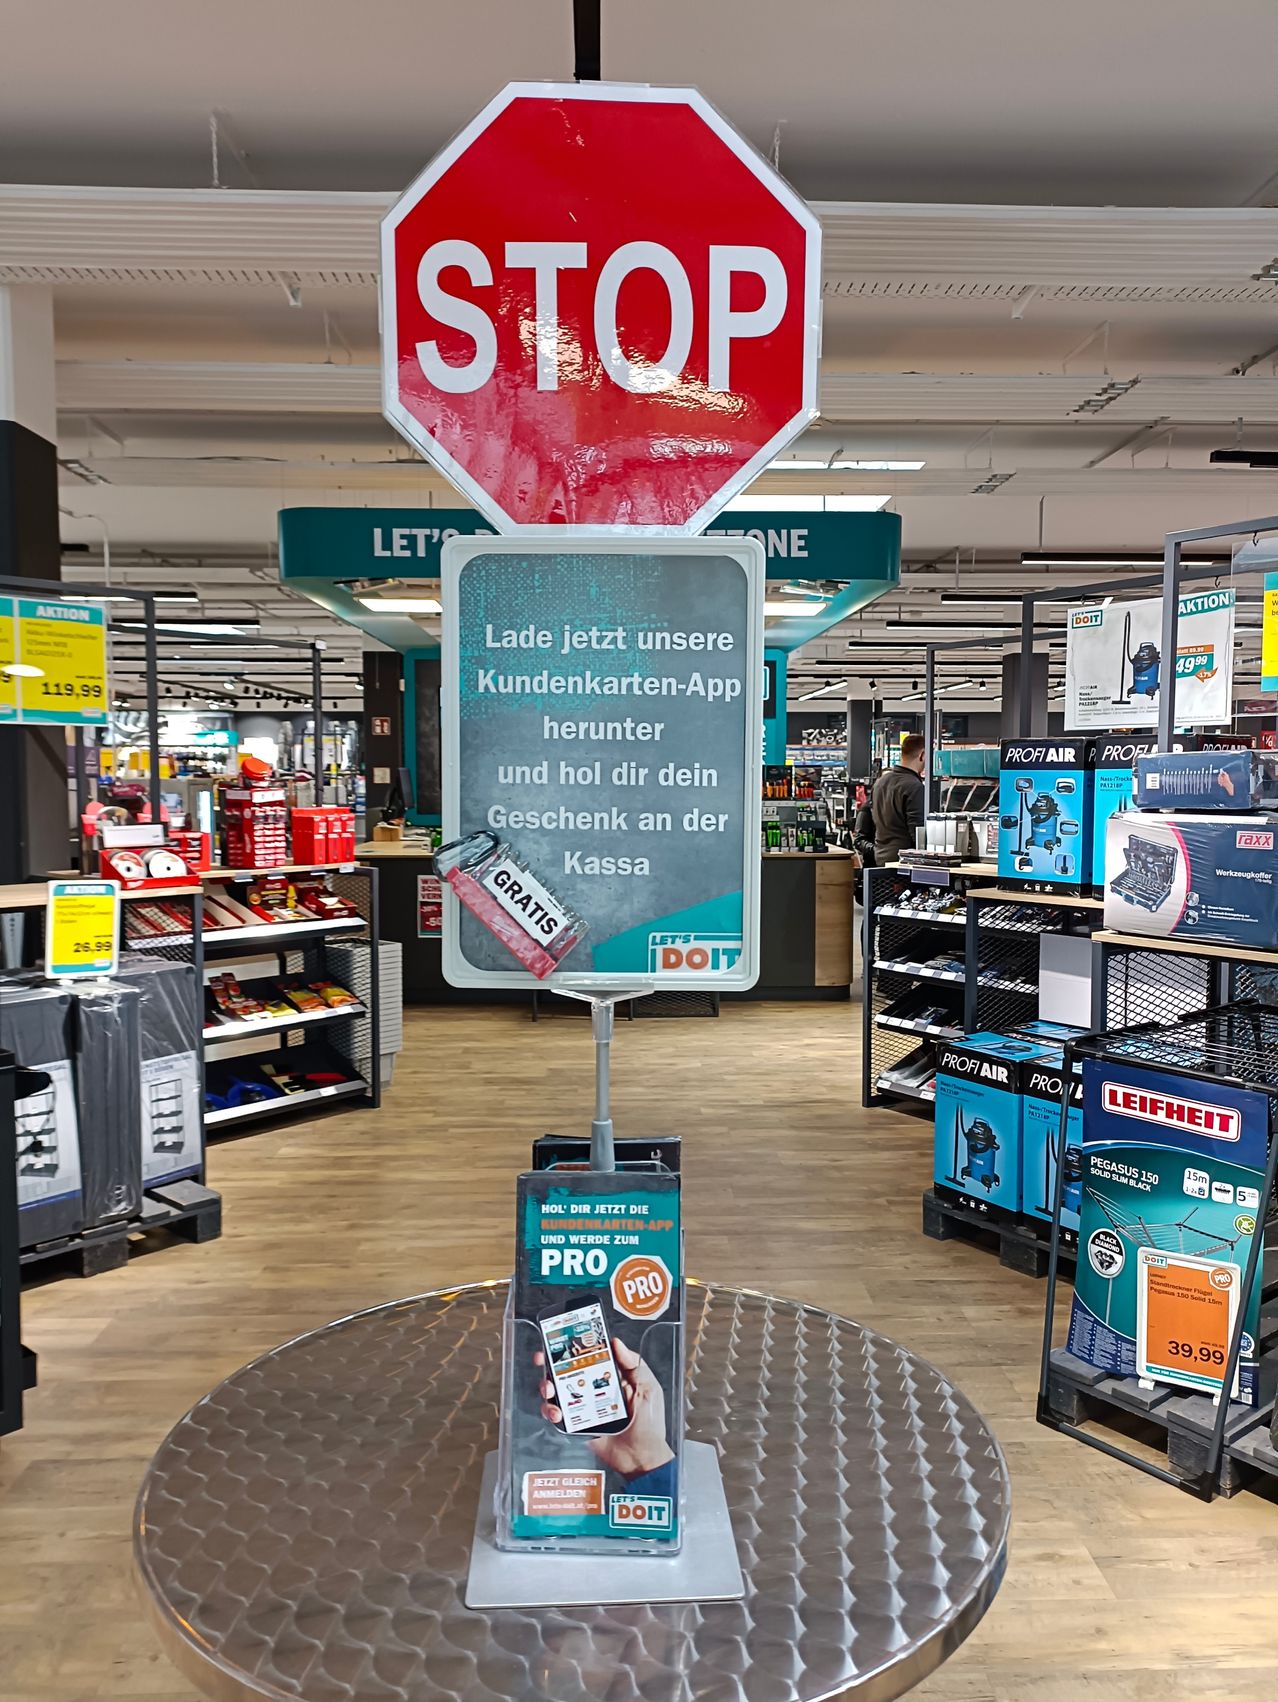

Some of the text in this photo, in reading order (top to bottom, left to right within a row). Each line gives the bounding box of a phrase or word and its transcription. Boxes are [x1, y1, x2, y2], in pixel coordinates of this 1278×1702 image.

[415, 239, 788, 394] STOP
[35, 605, 90, 621] AKTION
[485, 624, 734, 654] Lade jetzt unsere
[42, 682, 102, 699] 119,99
[477, 669, 741, 702] Kundenkarten-App
[543, 716, 664, 741] herunter
[498, 761, 718, 787] und hol dir dein
[487, 805, 728, 832] Geschenk an der
[1238, 835, 1271, 846] raxx
[564, 851, 650, 875] Kassa
[1215, 868, 1272, 880] Werkzeugkoffer
[493, 870, 558, 935] GRATIS
[73, 941, 112, 954] 26,99
[651, 934, 692, 946] LET'S
[662, 948, 741, 970] DOIT
[1108, 1089, 1234, 1132] LEIFHEIT
[1090, 1156, 1159, 1185] PEGASUS 150
[1187, 1170, 1208, 1184] 15m
[1090, 1168, 1152, 1192] SOLID SLIM BLACK
[1238, 1190, 1247, 1201] 5
[541, 1204, 649, 1215] HOL' DIR JETZT DIE
[541, 1219, 673, 1231] KUNDENKARTEN-APP
[541, 1235, 639, 1245] UND WERDE ZUM
[1095, 1240, 1120, 1253] DIAMOND
[1099, 1233, 1118, 1245] BLACK
[541, 1249, 608, 1276] PRO
[1150, 1280, 1193, 1293] Standtrockner
[1213, 1273, 1232, 1284] PRO
[622, 1271, 664, 1304] PRO
[1150, 1287, 1175, 1297] Pegasus
[1190, 1295, 1207, 1303] Solid
[1207, 1298, 1223, 1306] 15m
[1168, 1341, 1225, 1365] 39,99
[532, 1478, 597, 1486] JETZT GLEICH
[532, 1490, 586, 1498] ANMELDEN
[618, 1504, 666, 1520] DOIT
